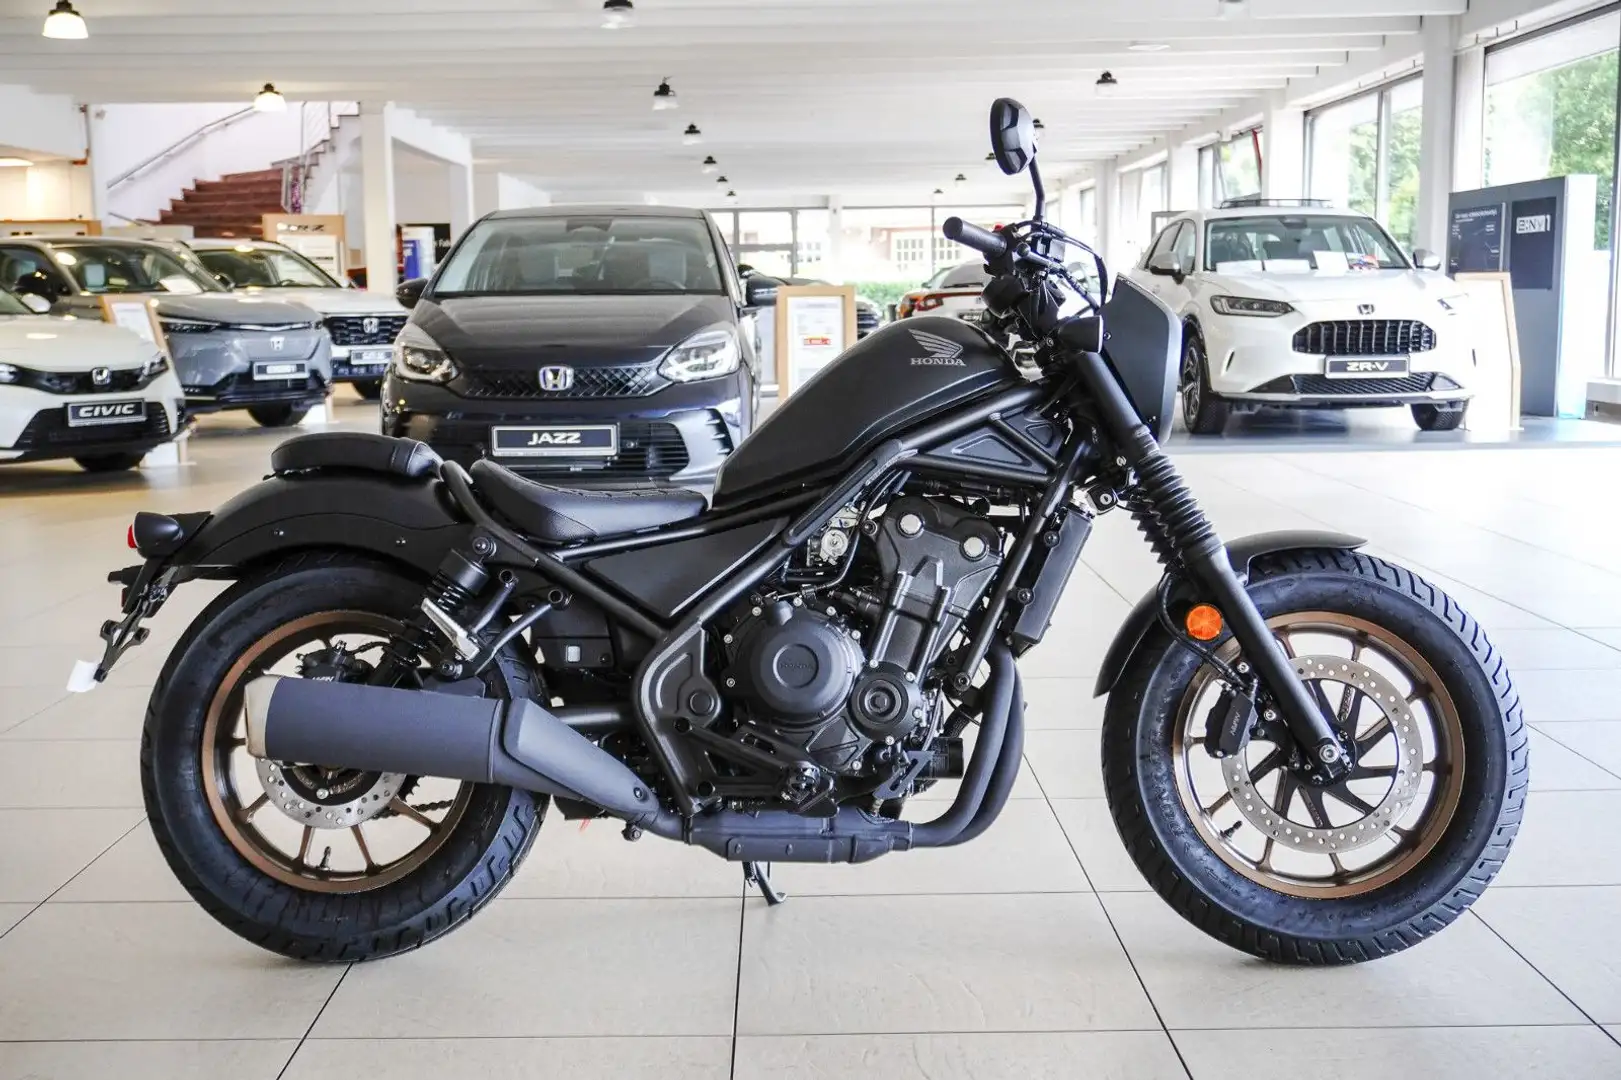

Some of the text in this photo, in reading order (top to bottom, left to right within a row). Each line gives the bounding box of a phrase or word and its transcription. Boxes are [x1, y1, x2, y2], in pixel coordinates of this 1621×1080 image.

[910, 358, 966, 366] HONDA
[1346, 361, 1389, 371] ZR-V
[79, 404, 135, 417] CIVIC
[527, 432, 581, 446] JAZZ
